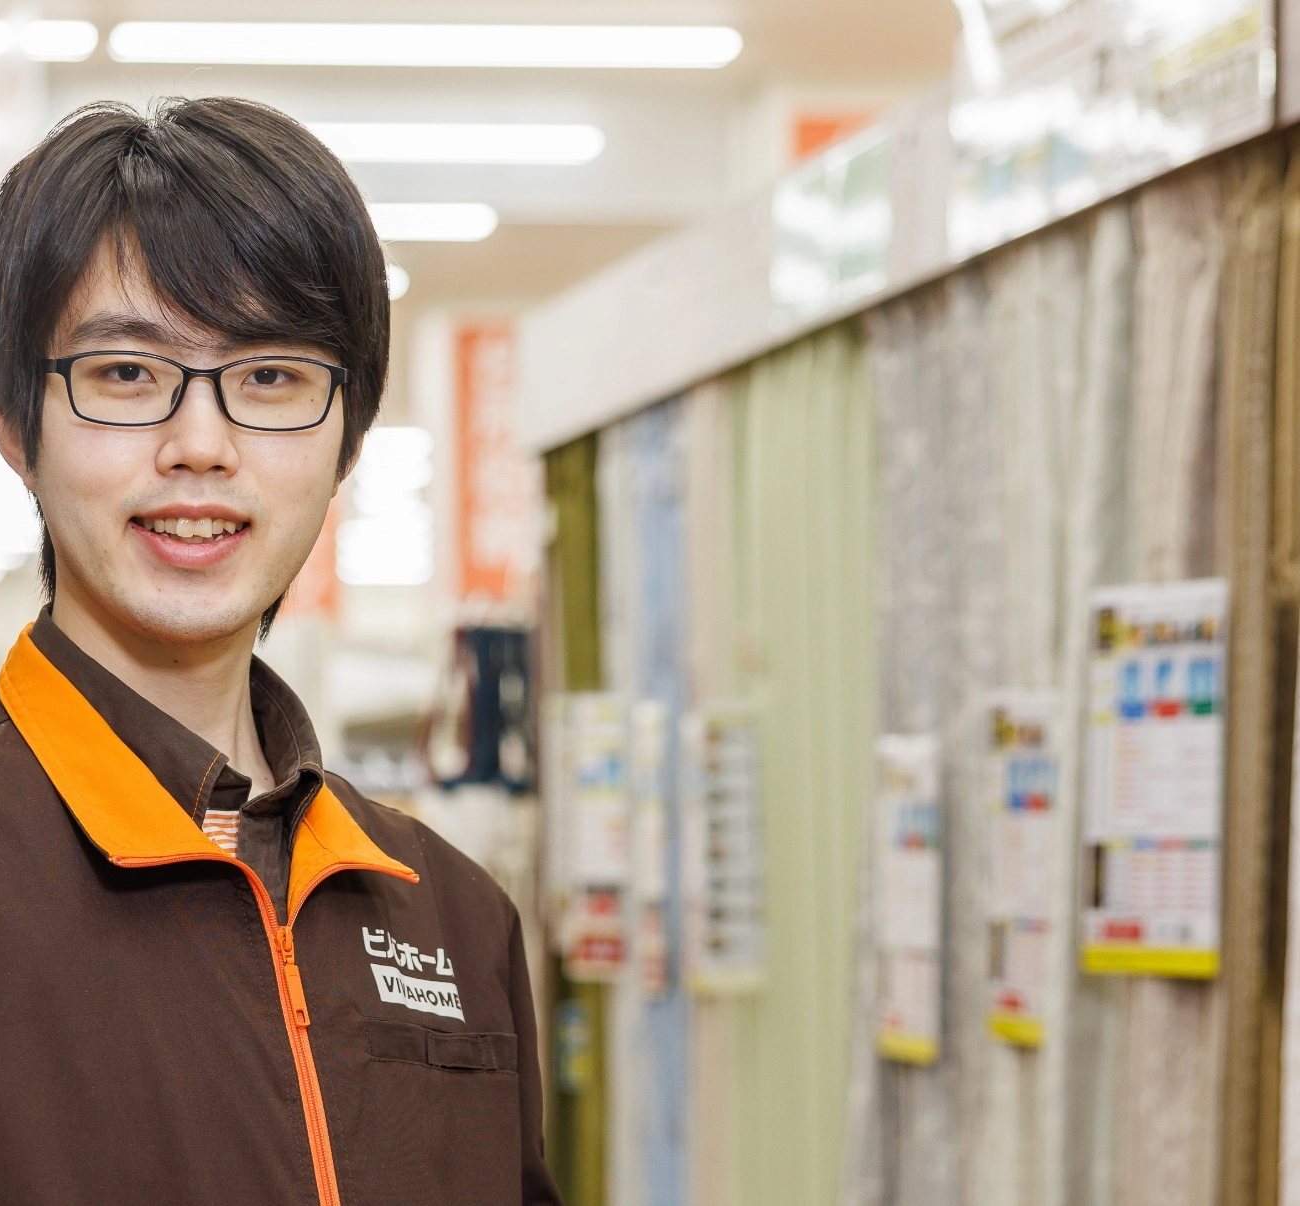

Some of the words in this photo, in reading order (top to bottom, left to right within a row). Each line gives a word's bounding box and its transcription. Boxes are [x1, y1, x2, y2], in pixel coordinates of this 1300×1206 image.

[361, 926, 455, 979] ビバホーム
[382, 975, 463, 1011] VIVAHOME
